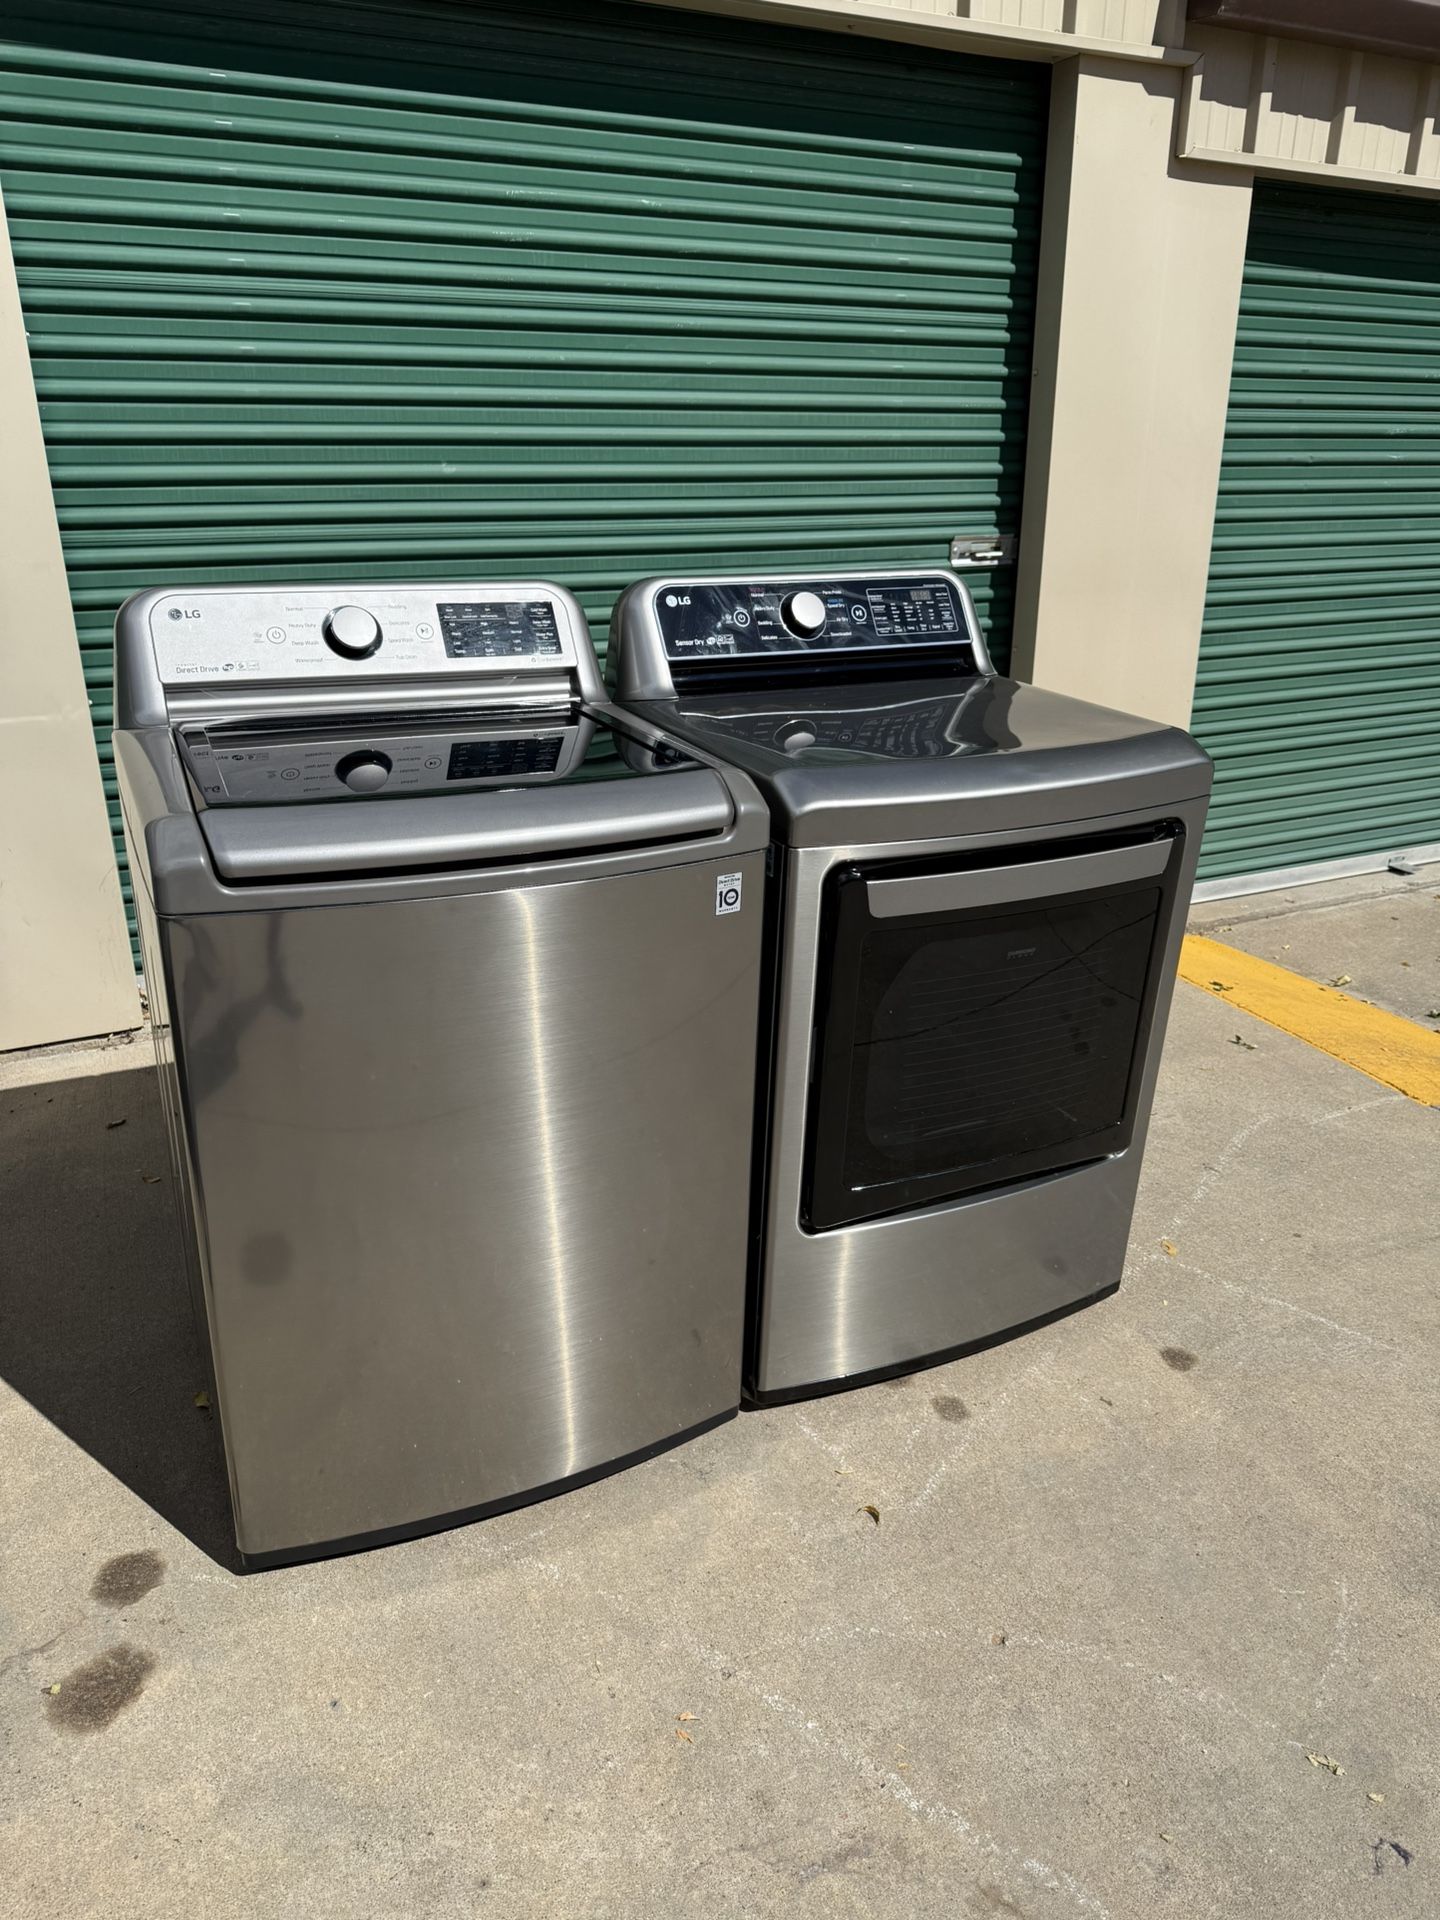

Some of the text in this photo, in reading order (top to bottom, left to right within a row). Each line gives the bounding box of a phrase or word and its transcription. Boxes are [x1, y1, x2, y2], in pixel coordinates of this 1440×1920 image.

[678, 596, 691, 605] LG
[185, 610, 200, 618] LG
[176, 666, 198, 674] Direct
[719, 888, 738, 908] 10
